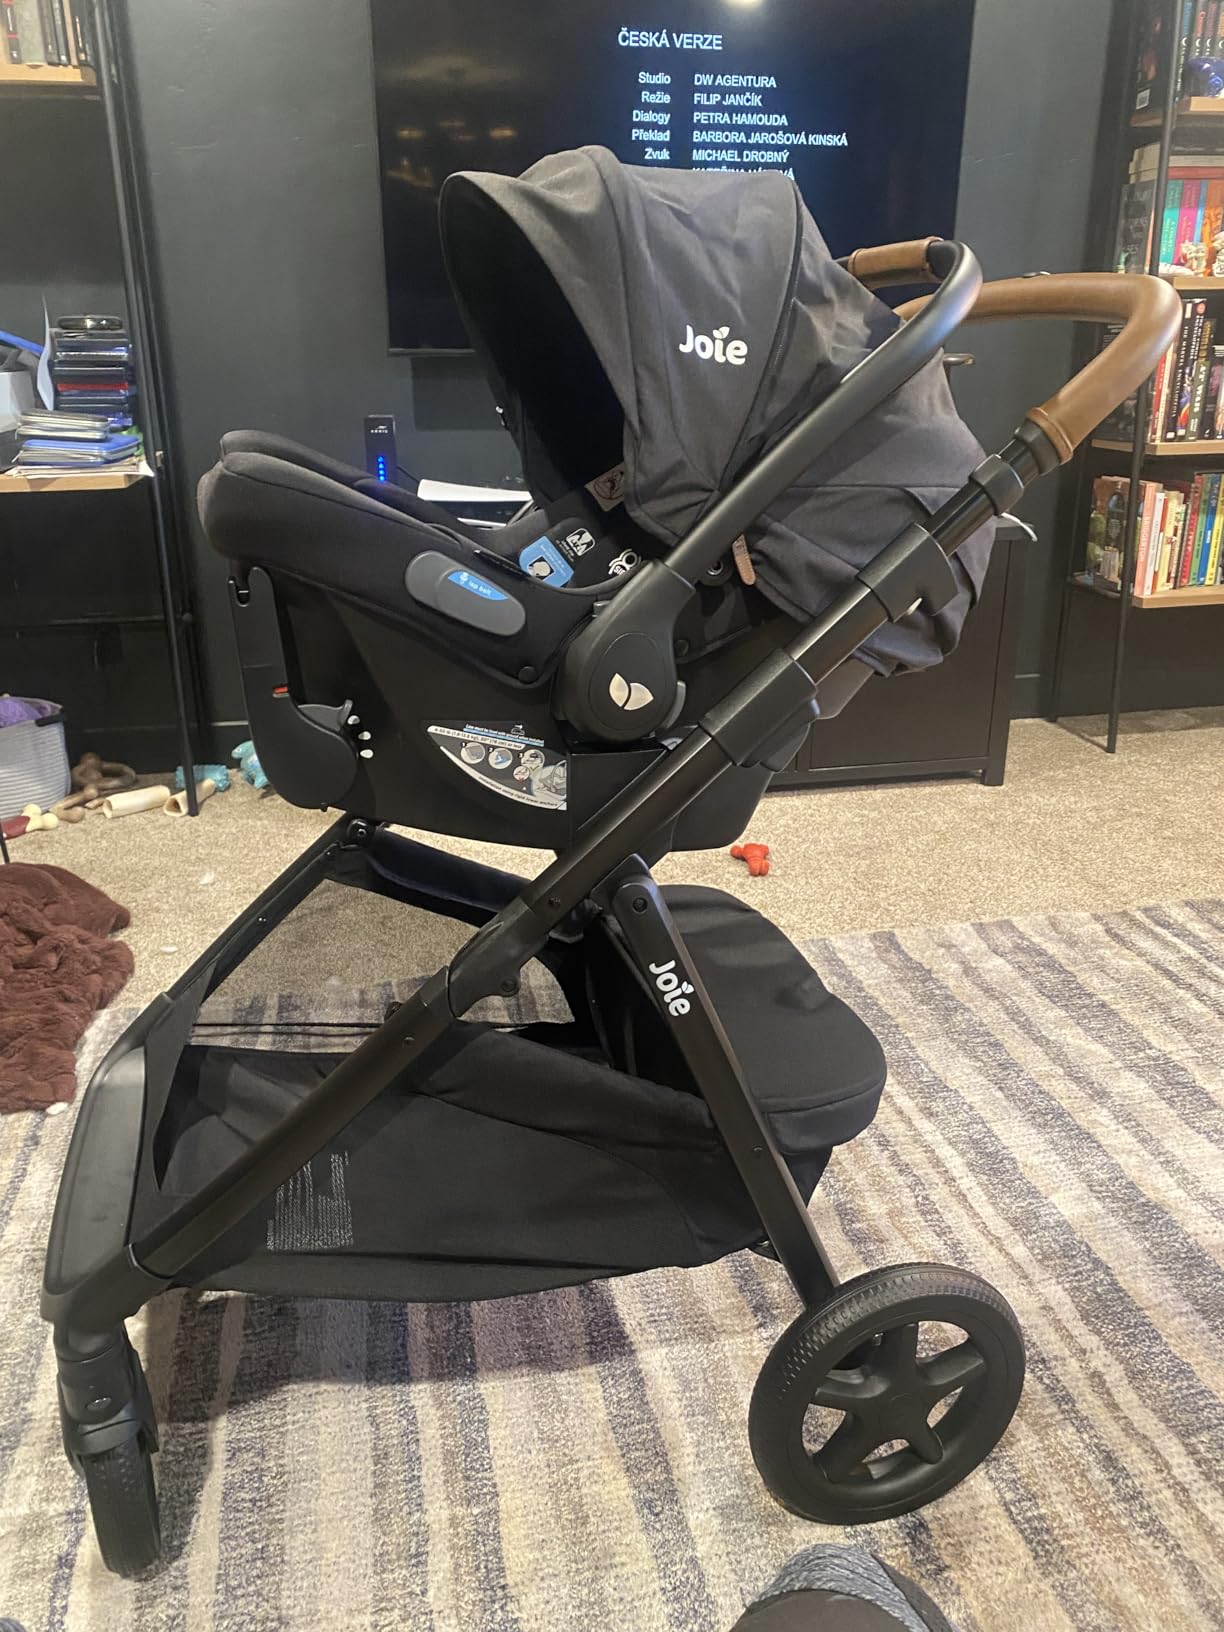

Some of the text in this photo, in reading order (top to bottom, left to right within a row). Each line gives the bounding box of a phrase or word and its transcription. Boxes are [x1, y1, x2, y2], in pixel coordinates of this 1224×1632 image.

[618, 28, 722, 50] ČESKÁ VERZE
[638, 72, 671, 85] Studio
[694, 74, 776, 88] DW AGENTURA
[641, 91, 671, 104] Režie
[694, 92, 762, 106] FILIP JANČÍK
[632, 110, 670, 124] Dialogy
[694, 113, 788, 126] PETRA HAMOUDA
[632, 129, 670, 142] Překlad
[693, 130, 848, 146] BARBORA JAROŠOVÁ KINSKÁ
[645, 148, 670, 160] Zvuk
[693, 149, 789, 163] MICHAEL DROBNÝ
[679, 324, 748, 365] Joie
[649, 960, 694, 1016] Joie
